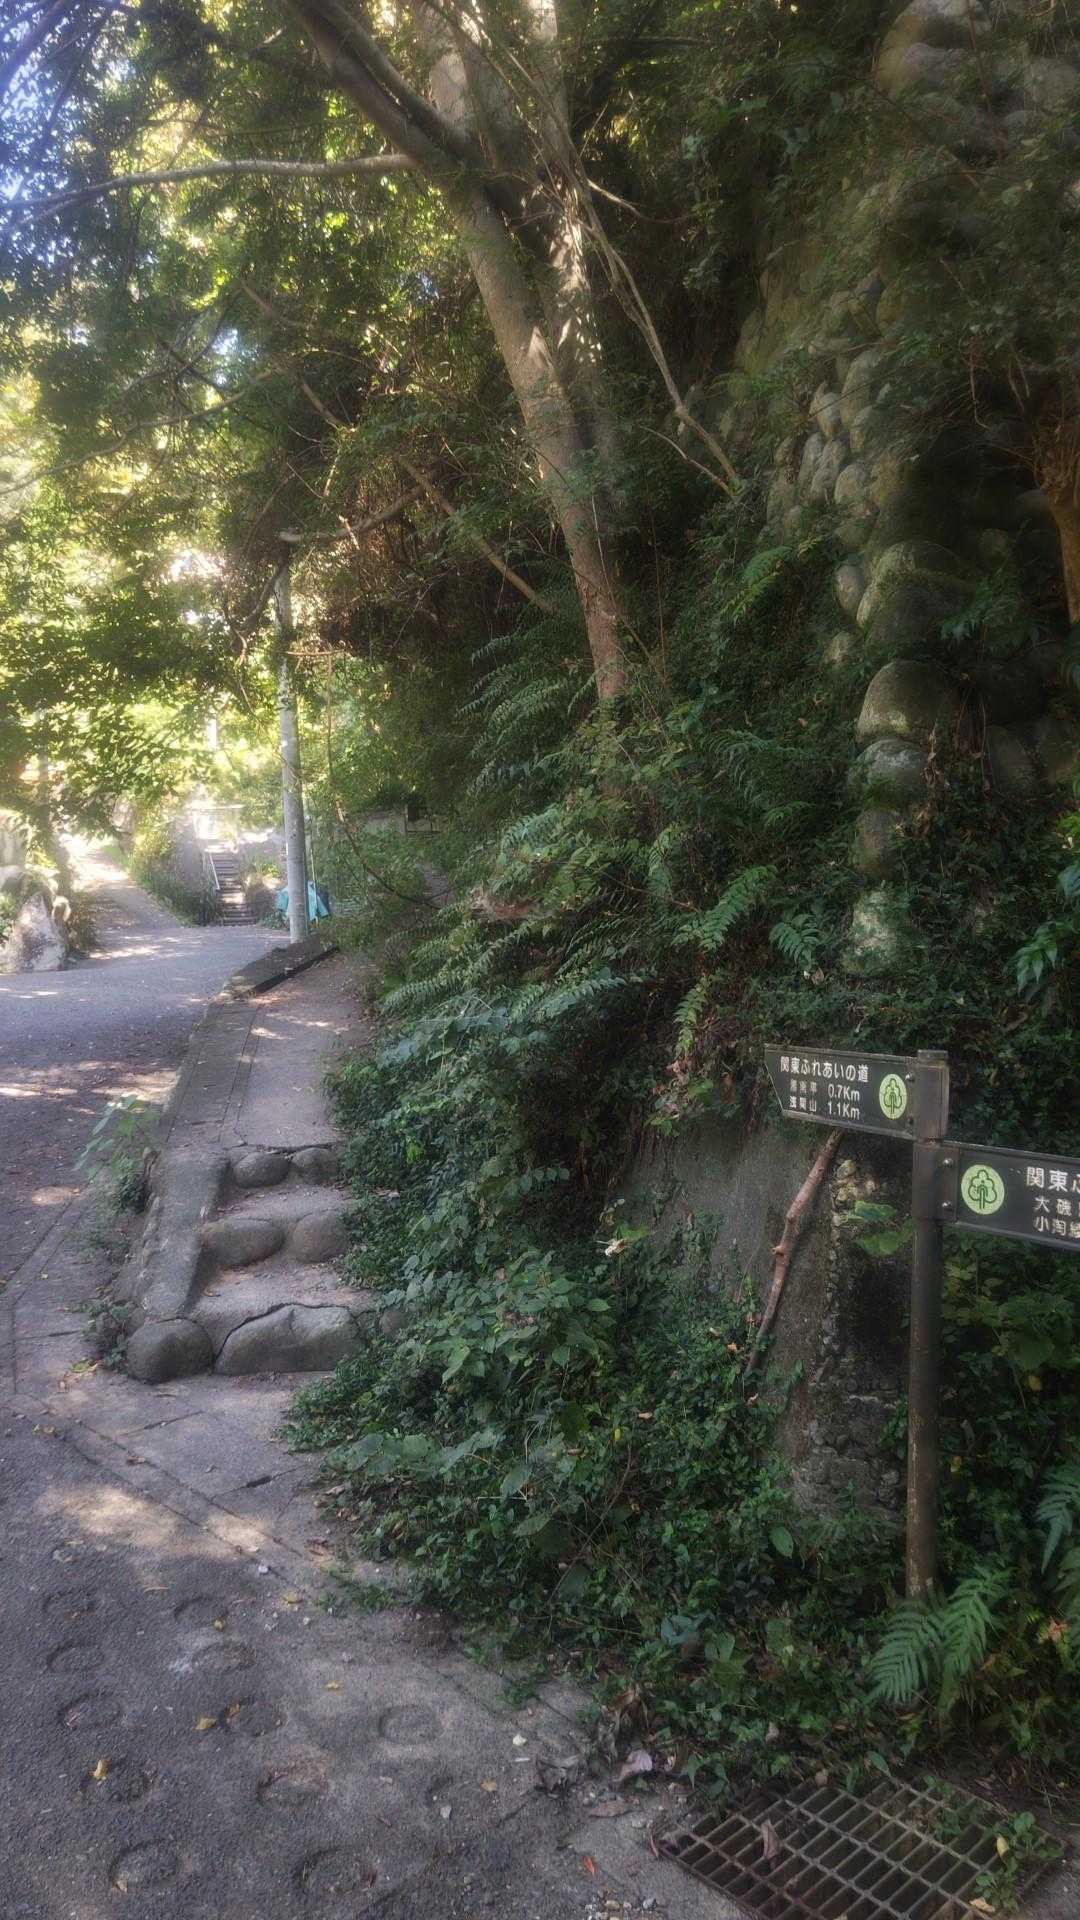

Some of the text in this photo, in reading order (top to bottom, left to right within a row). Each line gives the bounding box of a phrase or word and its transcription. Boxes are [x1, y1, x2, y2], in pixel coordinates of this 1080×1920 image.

[780, 1055, 869, 1083] 関東ふれあいの道
[827, 1083, 860, 1101] 0.7Km
[827, 1099, 860, 1120] 1.1Km
[1033, 1195, 1080, 1218] 大磯
